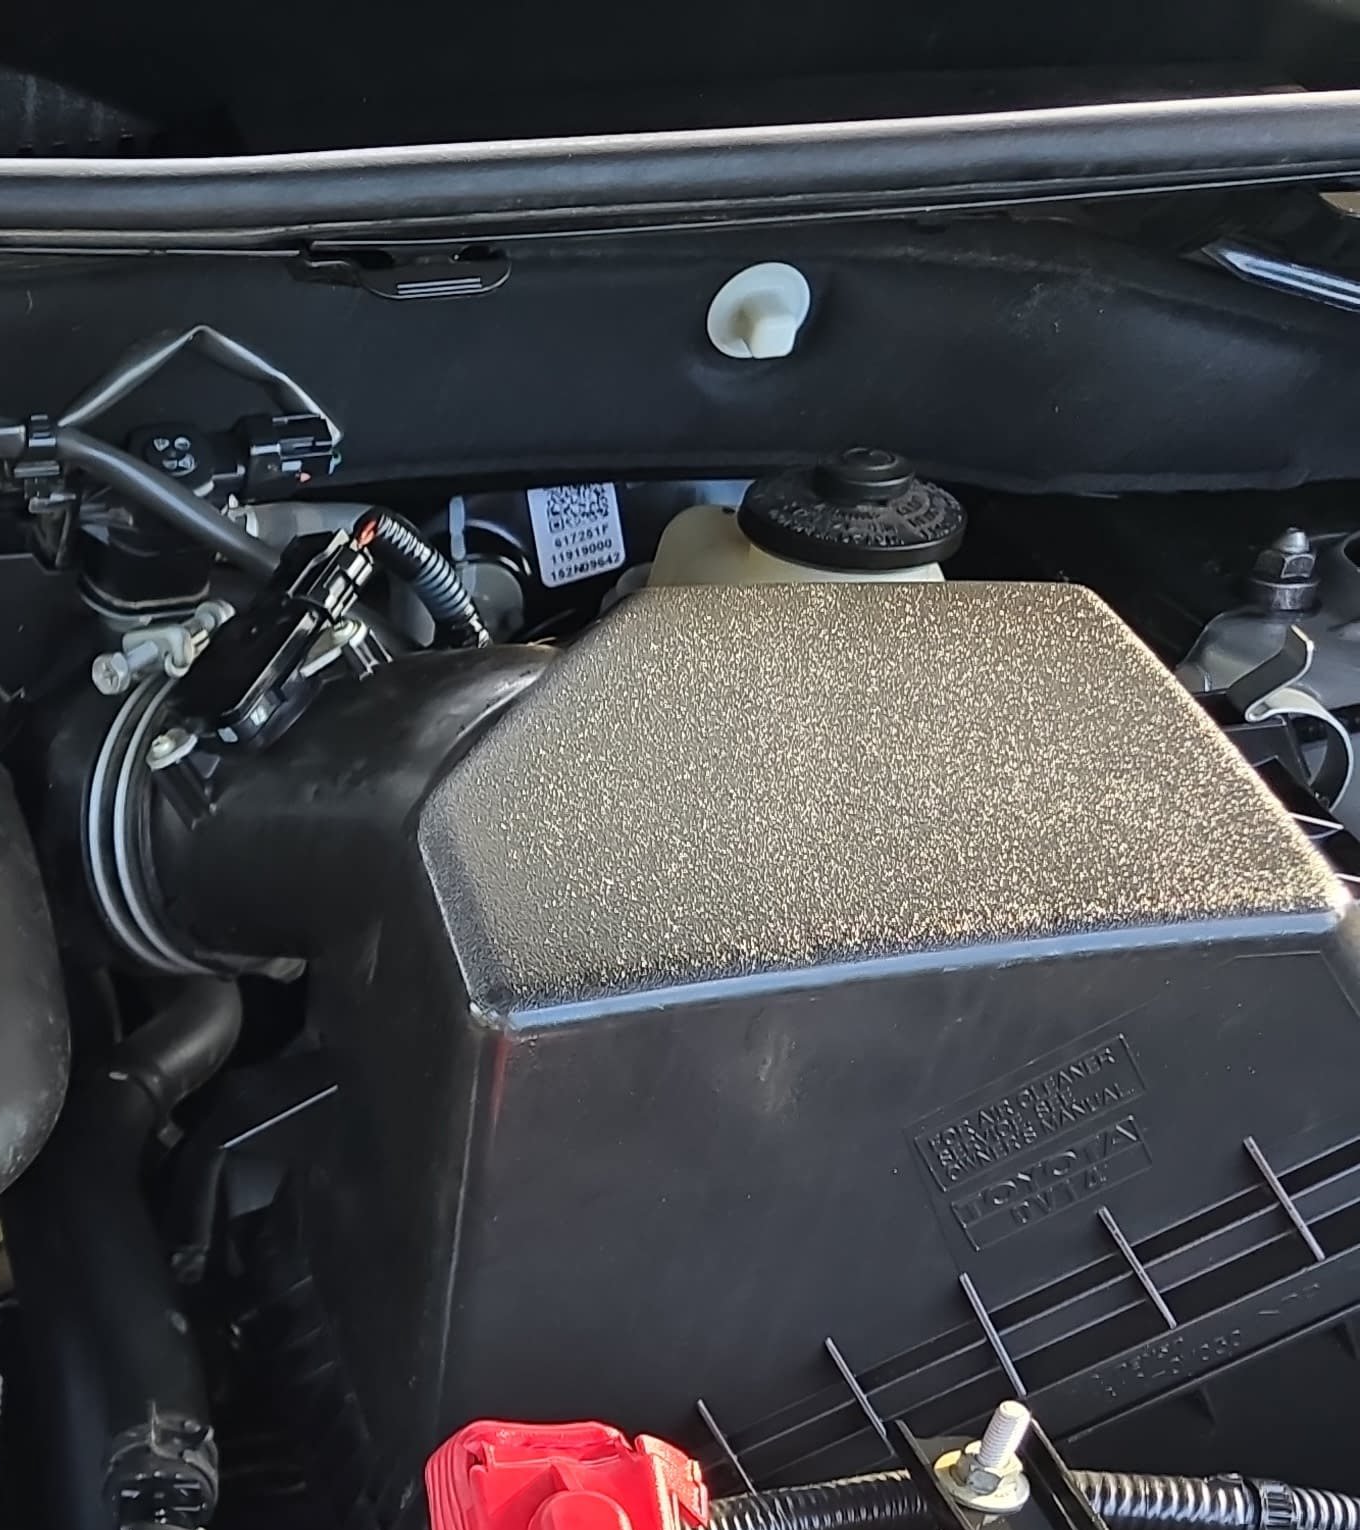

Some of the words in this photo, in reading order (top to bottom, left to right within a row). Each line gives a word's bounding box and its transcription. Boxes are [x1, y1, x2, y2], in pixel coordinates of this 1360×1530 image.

[929, 1119, 976, 1151] FOR
[979, 1098, 1015, 1125] AIR
[1016, 1048, 1116, 1108] CLEANER
[1034, 1086, 1075, 1119] SEE
[954, 1122, 1138, 1222] TOYOTA
